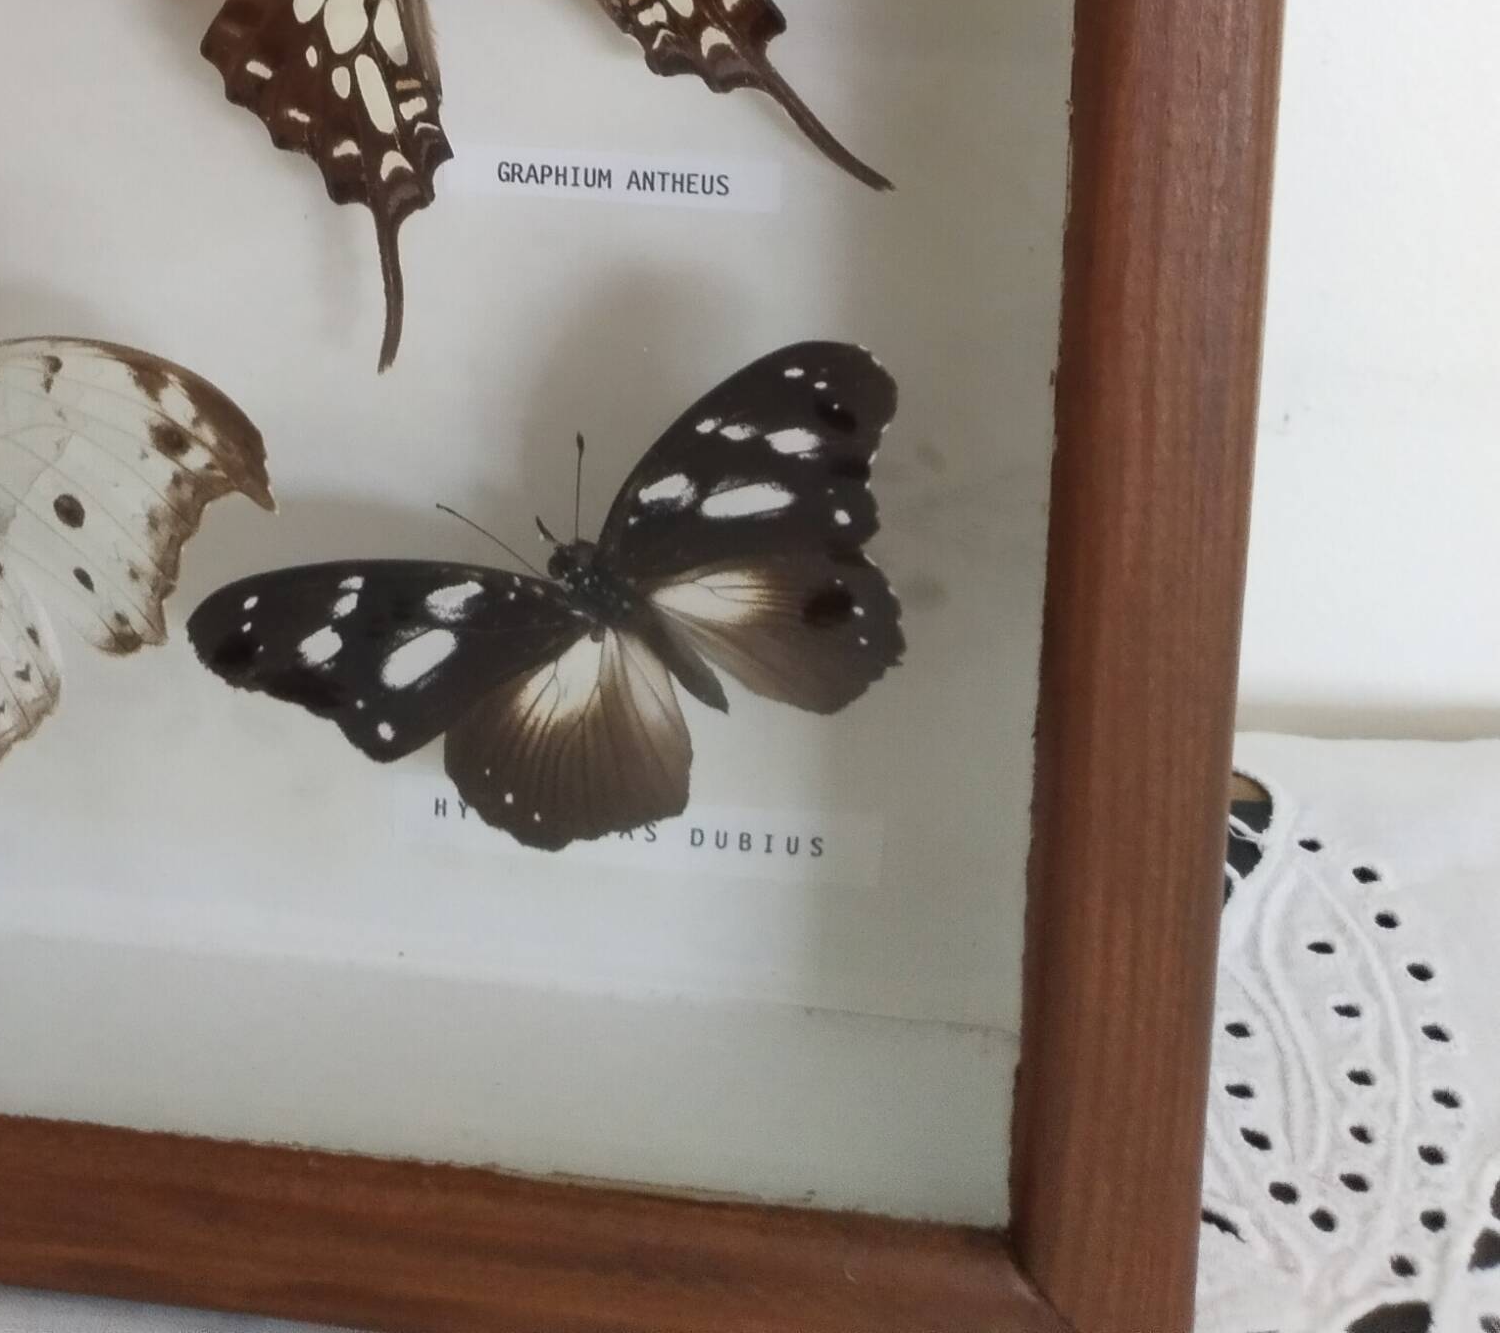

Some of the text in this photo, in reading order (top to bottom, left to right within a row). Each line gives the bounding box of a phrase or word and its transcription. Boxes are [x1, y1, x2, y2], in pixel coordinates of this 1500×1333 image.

[497, 161, 730, 196] GRAPHIUM ANTHEUS
[690, 827, 824, 857] DUBIUS
